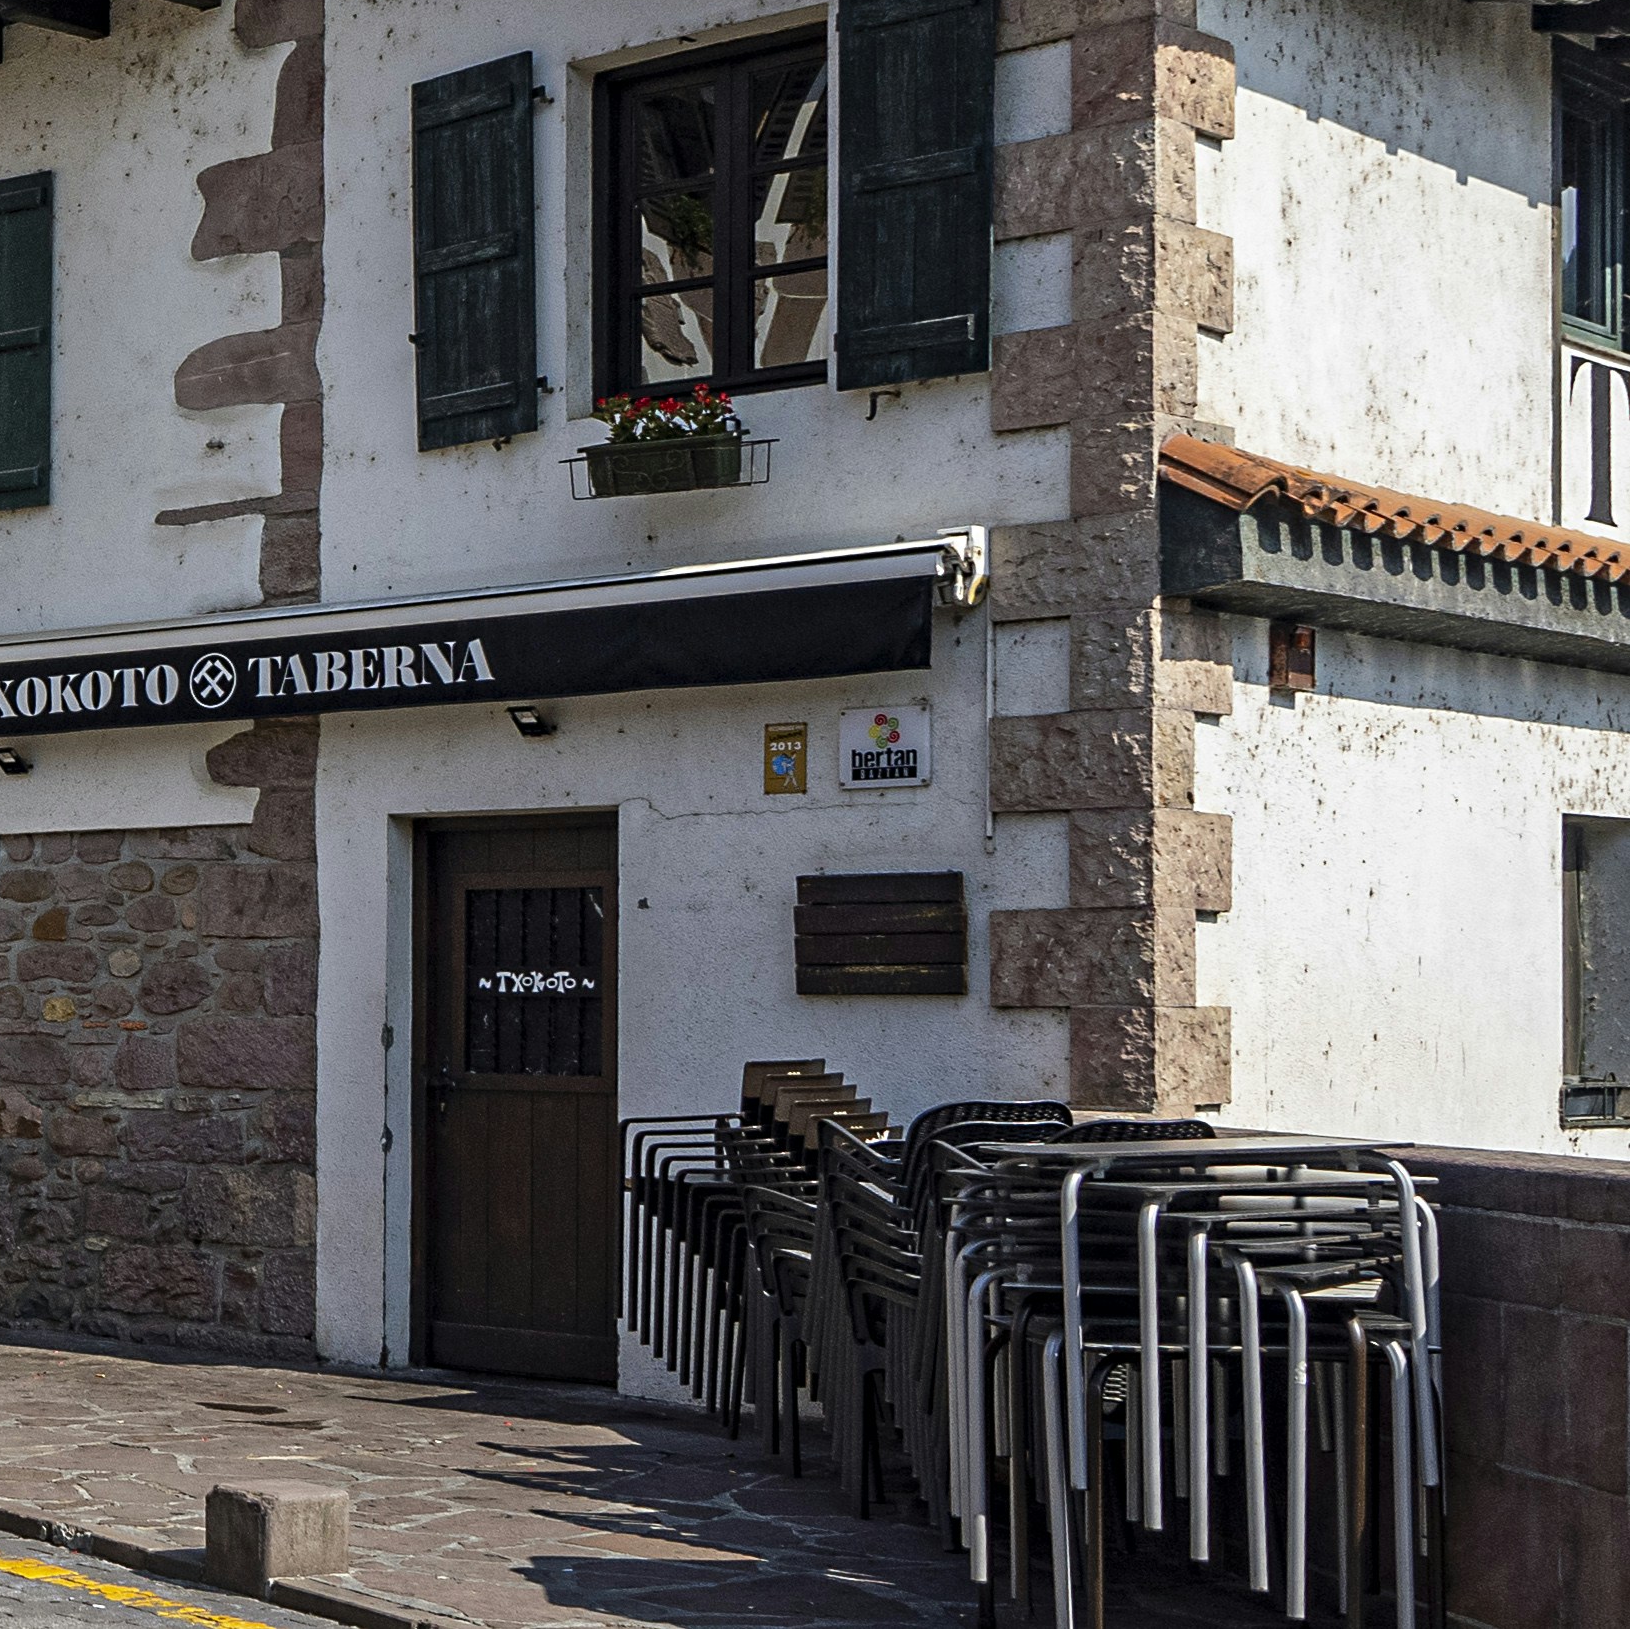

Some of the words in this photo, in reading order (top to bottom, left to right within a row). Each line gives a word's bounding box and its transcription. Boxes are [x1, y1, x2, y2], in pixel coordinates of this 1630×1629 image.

[247, 638, 496, 697] TABERNA
[769, 741, 802, 751] 2013
[851, 747, 918, 768] bertan
